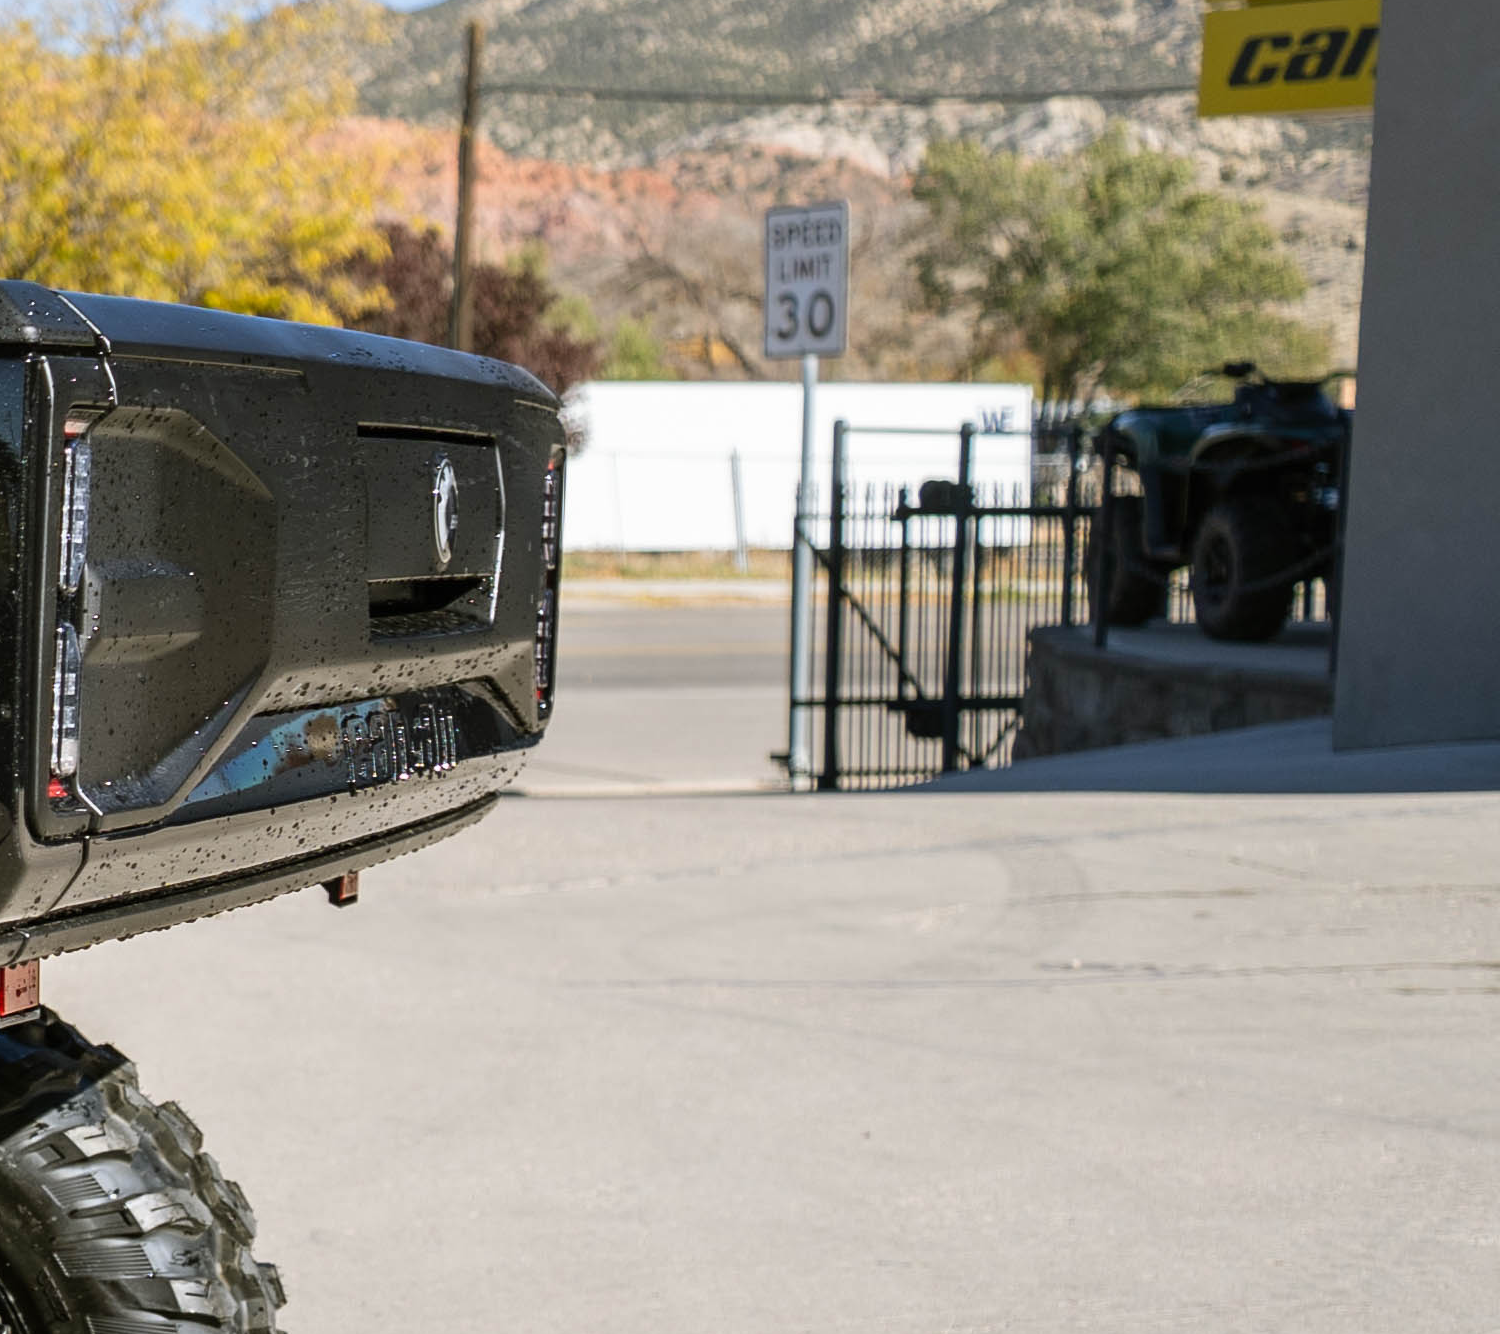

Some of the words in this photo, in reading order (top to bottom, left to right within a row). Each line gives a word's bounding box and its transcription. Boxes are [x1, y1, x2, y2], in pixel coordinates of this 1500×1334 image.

[773, 219, 842, 248] SPEED
[779, 254, 831, 283] LIMIT
[777, 289, 835, 343] 30
